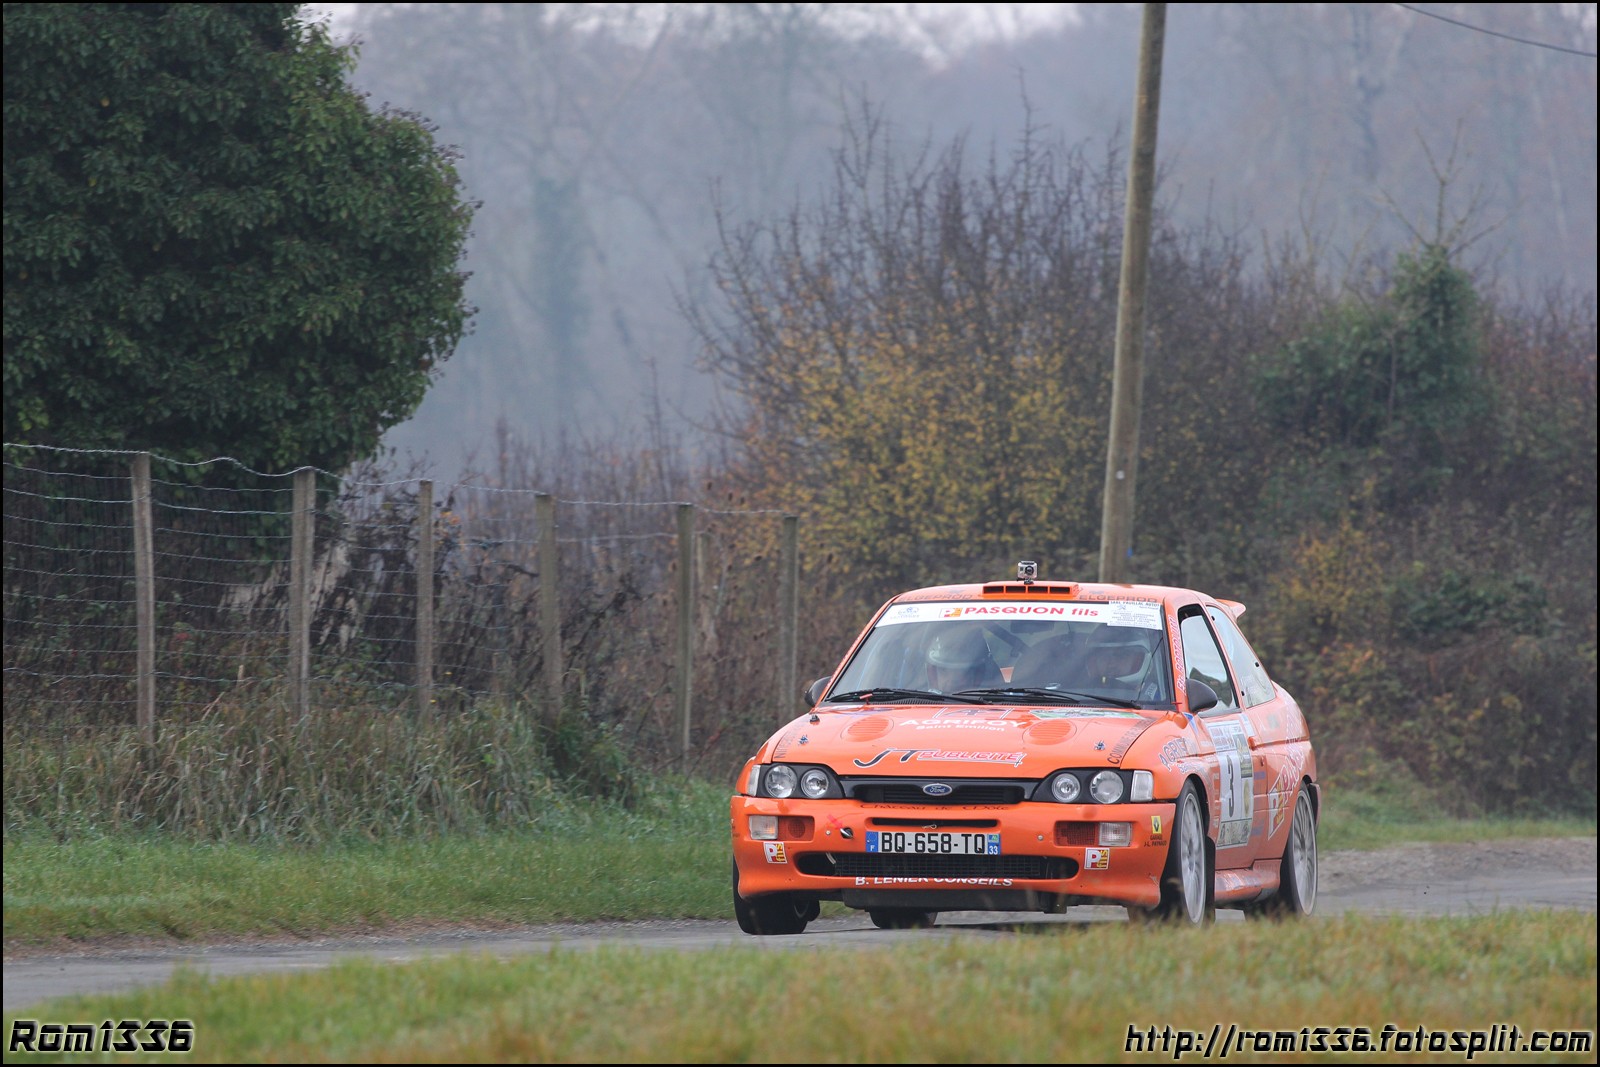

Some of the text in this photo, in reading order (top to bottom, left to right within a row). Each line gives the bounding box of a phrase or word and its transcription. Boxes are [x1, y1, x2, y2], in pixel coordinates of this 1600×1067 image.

[1079, 594, 1158, 602] ELGEPROD
[964, 606, 1099, 616] PASQUON fils
[900, 719, 1028, 728] AGRIFOY
[929, 785, 946, 794] Ford
[1226, 754, 1235, 818] 3
[881, 832, 986, 854] BQ-658-TQ
[988, 845, 999, 856] 33
[855, 877, 870, 886] B.
